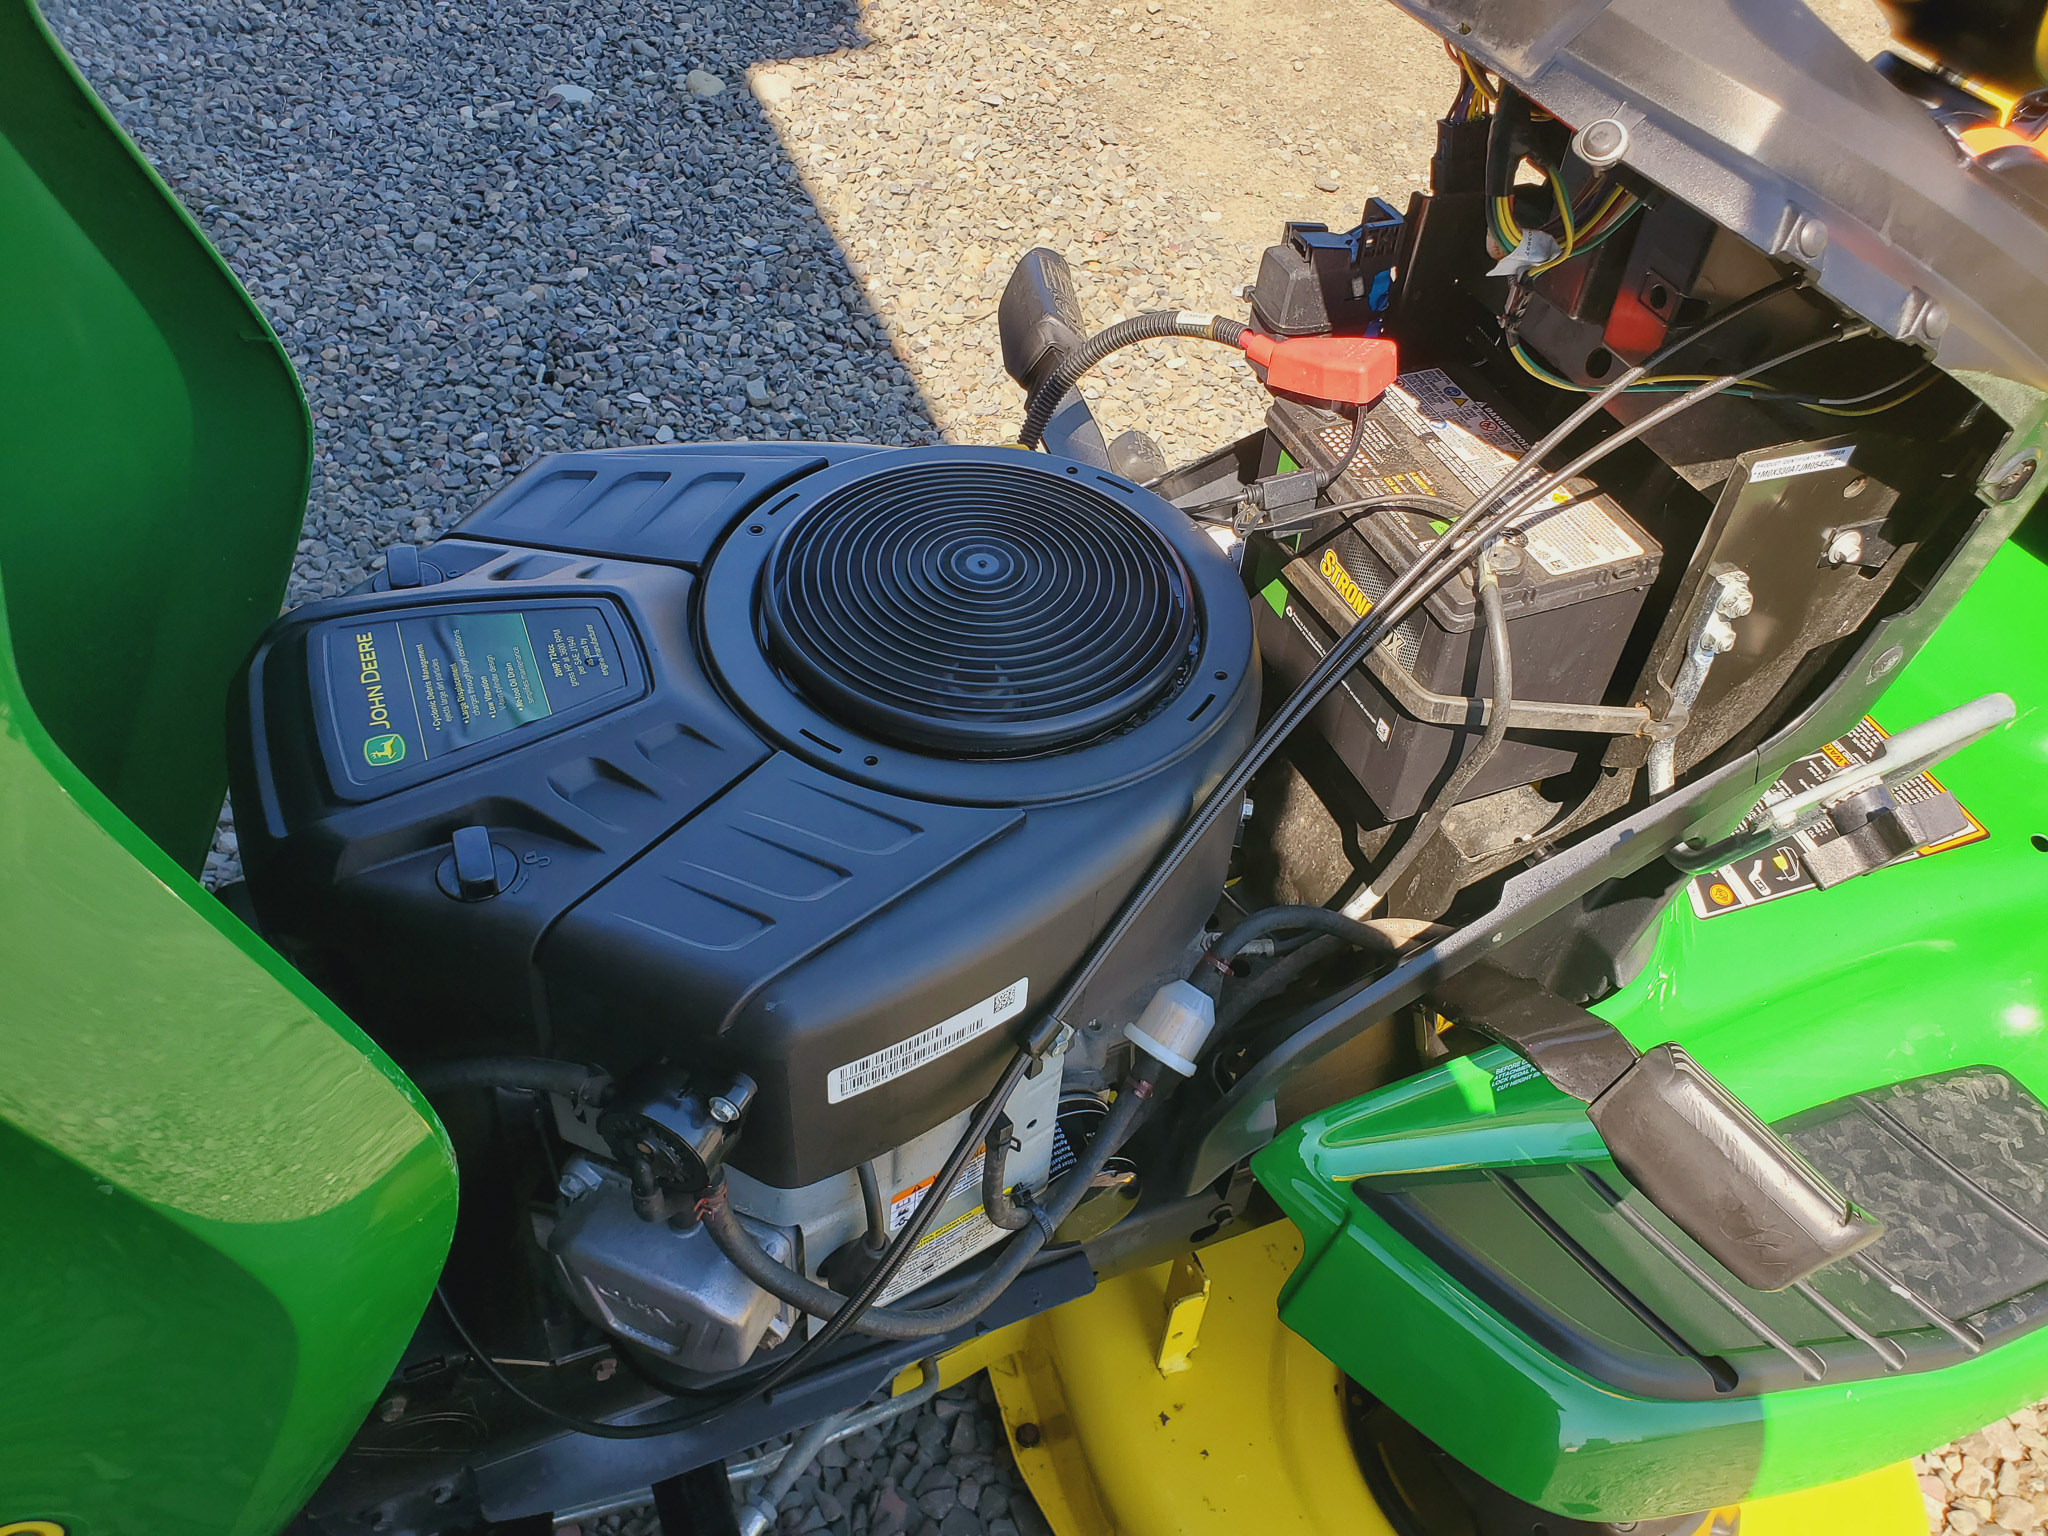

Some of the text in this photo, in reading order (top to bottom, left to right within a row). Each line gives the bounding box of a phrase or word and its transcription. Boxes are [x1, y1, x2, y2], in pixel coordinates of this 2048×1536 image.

[1755, 460, 1781, 469] PRODUCT
[1782, 453, 1821, 464] IDENTIFICATION
[552, 628, 563, 643] RPM
[557, 642, 568, 656] 3600
[566, 635, 587, 674] per SAE J1940
[579, 636, 588, 645] by
[584, 622, 610, 676] engine manufacturer
[452, 628, 481, 716] charges through tough conditions
[511, 645, 535, 704] simplifies maintenance
[546, 643, 564, 677] 20HP, 724cc
[563, 662, 572, 672] HP
[567, 670, 579, 687] gross
[586, 658, 593, 666] as
[356, 632, 391, 728] JOHN DEERE
[415, 643, 442, 726] Cyclonic Debris Management
[430, 657, 454, 722] ejects large dirt particles
[449, 662, 470, 719] Large Displacement
[478, 675, 496, 714] Low Vibration
[485, 653, 507, 710] V-twin cylinder design
[504, 661, 523, 707] No-tool Oil Drain
[1492, 1076, 1507, 1086] LOCK
[1509, 1068, 1528, 1079] PEDAL
[1496, 1082, 1508, 1091] CUT
